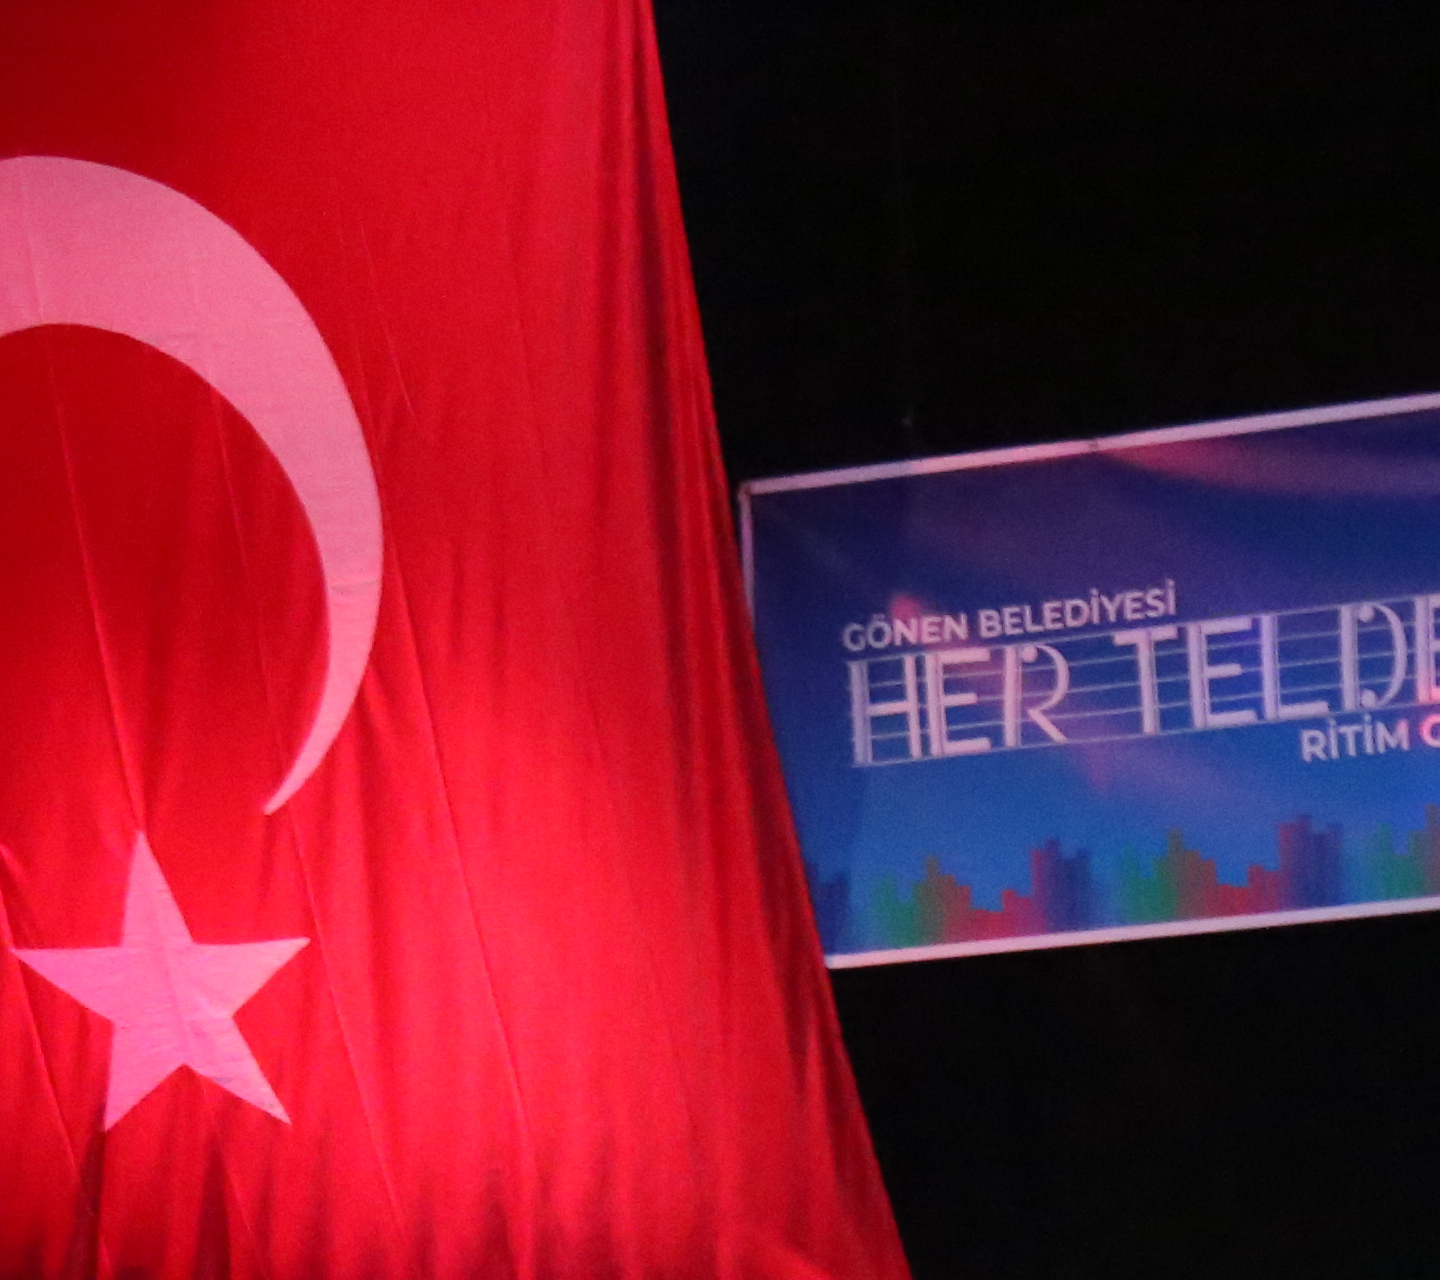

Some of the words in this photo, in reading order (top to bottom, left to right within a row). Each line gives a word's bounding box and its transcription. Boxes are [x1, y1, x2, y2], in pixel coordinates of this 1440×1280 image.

[842, 612, 969, 651] GÖNEN
[977, 578, 1177, 639] BELEDİYESİ
[848, 642, 1070, 767] HER
[1300, 713, 1410, 763] RİTİM
